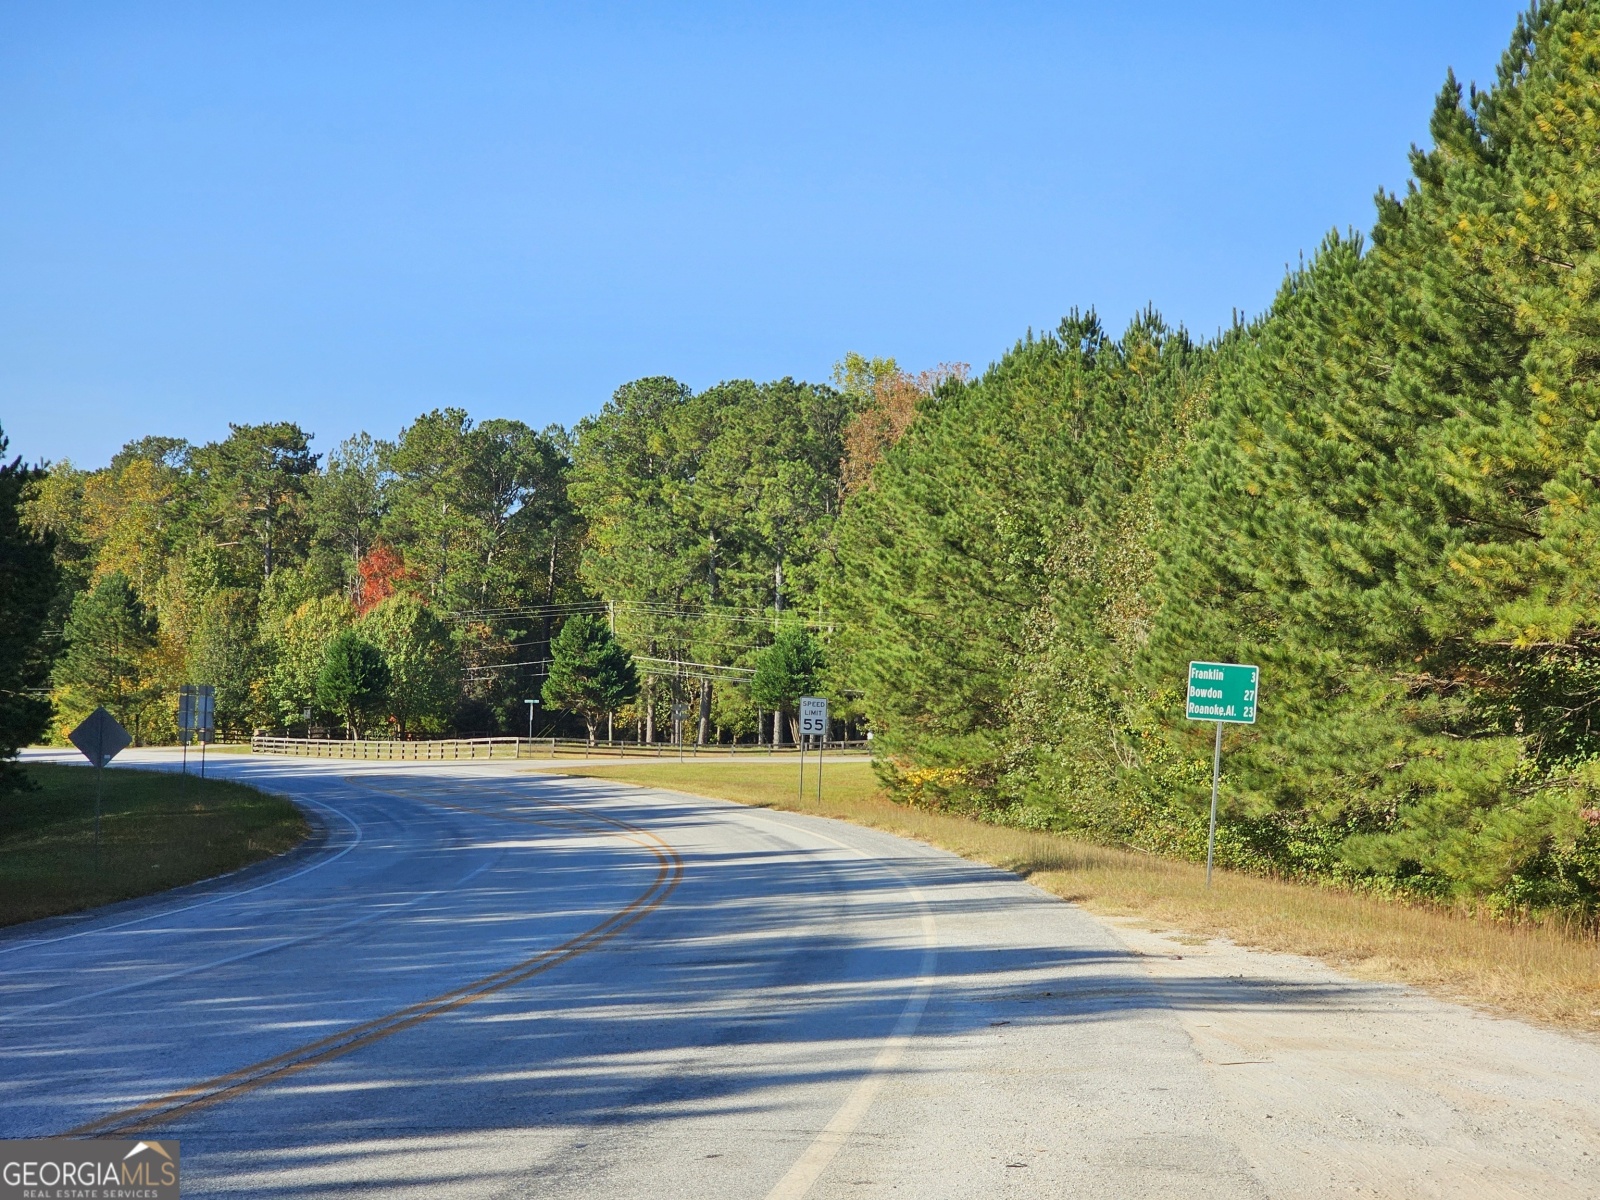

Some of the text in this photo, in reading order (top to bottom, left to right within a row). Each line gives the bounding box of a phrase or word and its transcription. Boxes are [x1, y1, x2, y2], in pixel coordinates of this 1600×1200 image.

[1191, 668, 1256, 683] Franklin 3
[1189, 686, 1255, 701] Bowdon 27
[1243, 706, 1254, 718] 23
[803, 718, 824, 731] 55
